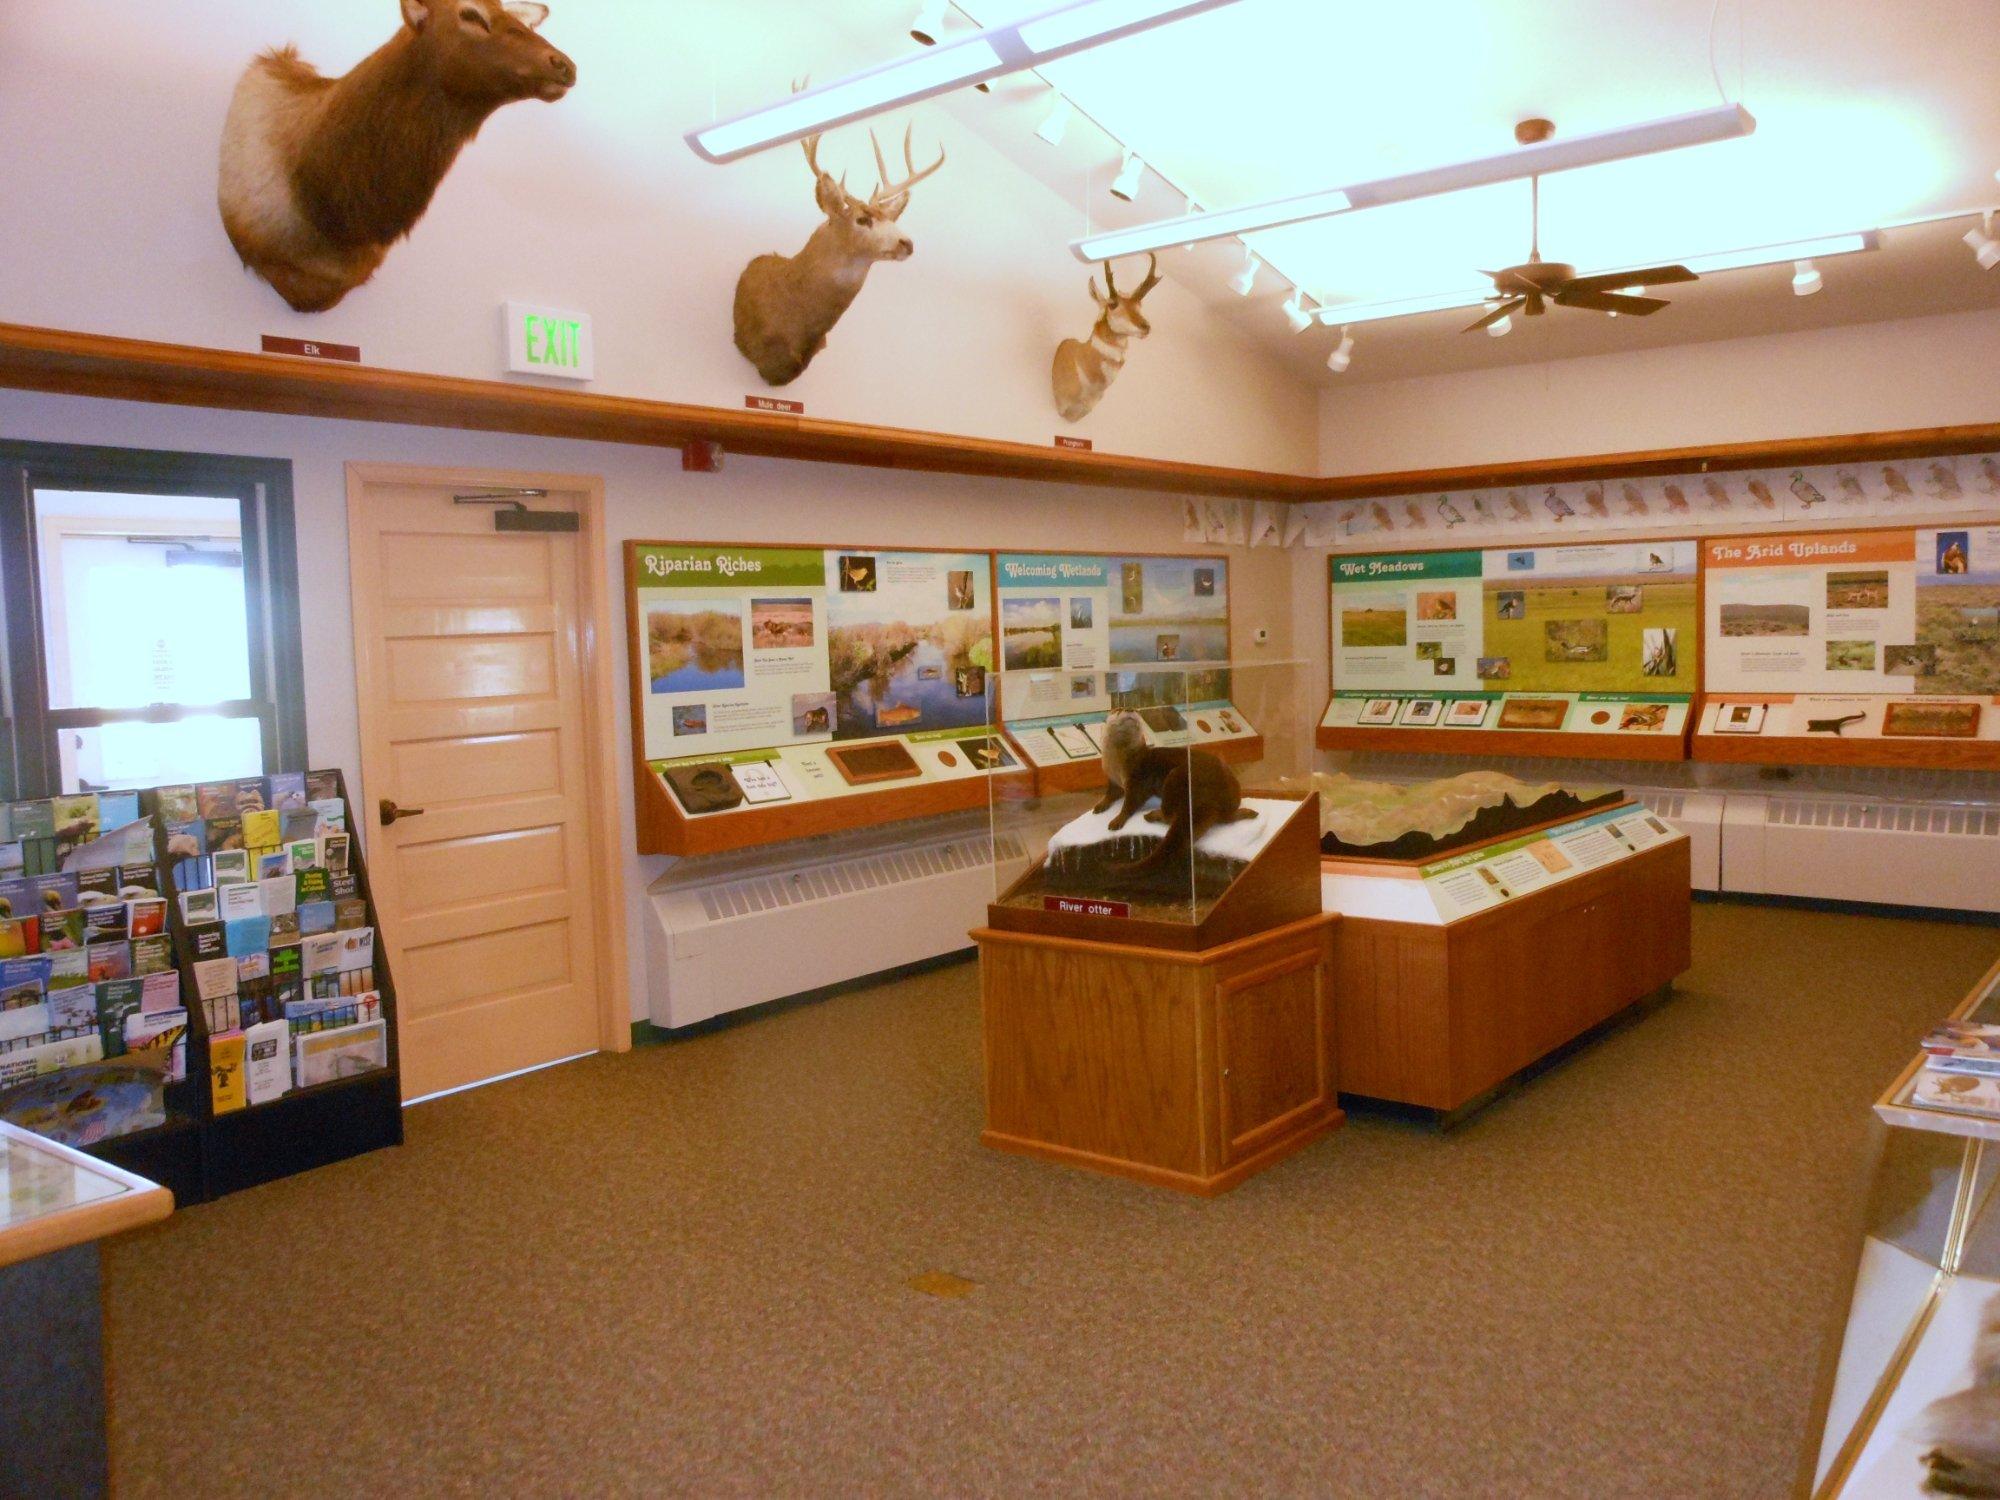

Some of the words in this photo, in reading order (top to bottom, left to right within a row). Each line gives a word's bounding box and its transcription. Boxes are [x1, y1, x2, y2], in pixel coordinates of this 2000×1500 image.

[525, 314, 581, 368] EXIT
[304, 343, 320, 355] Elk
[758, 399, 774, 409] Mule
[776, 401, 791, 411] deer
[1711, 544, 1742, 560] The
[1745, 544, 1784, 560] Arid
[1788, 541, 1857, 558] Uplands
[644, 555, 712, 576] Riparian
[716, 555, 762, 576] Riches
[1005, 562, 1057, 579] Welcoming
[1059, 563, 1102, 578] Wetlands
[1340, 562, 1365, 576] Wet
[1369, 561, 1424, 576] Meadows
[333, 877, 354, 888] Steel
[334, 886, 354, 896] Shot
[1059, 901, 1083, 912] River
[1088, 905, 1112, 915] otter
